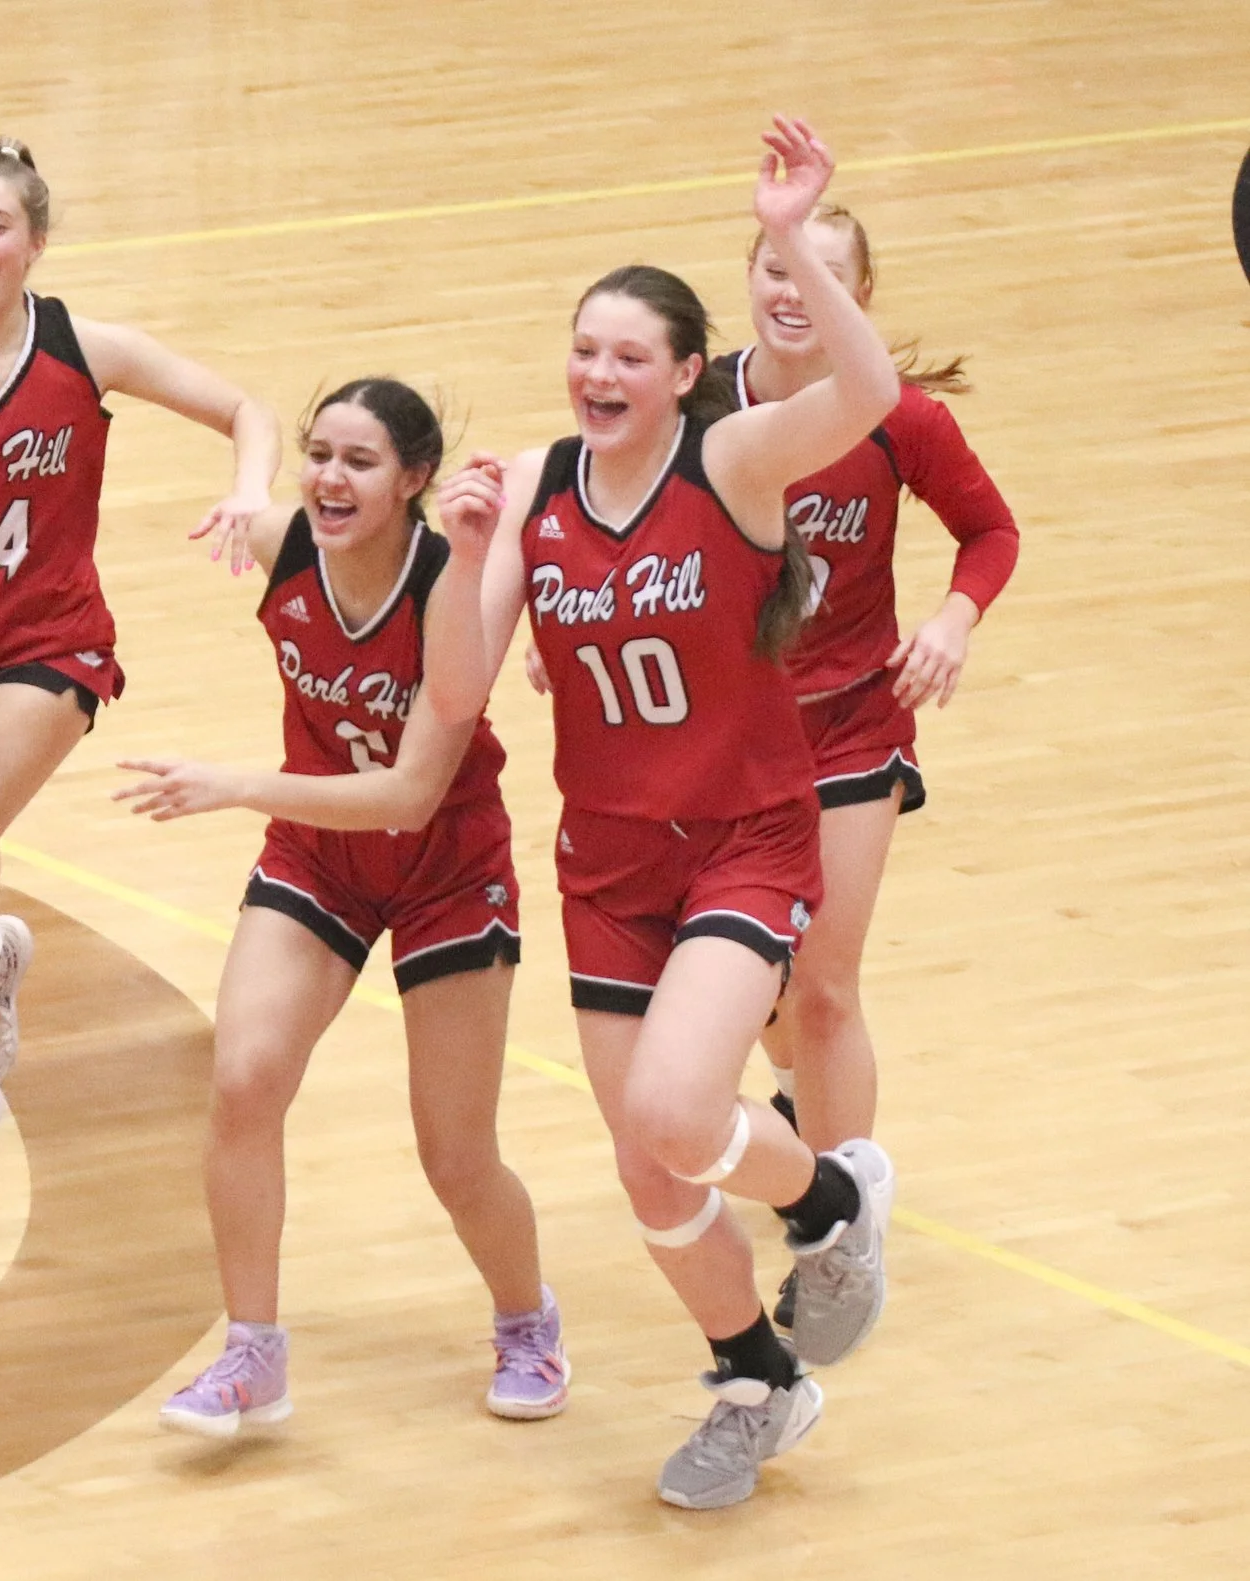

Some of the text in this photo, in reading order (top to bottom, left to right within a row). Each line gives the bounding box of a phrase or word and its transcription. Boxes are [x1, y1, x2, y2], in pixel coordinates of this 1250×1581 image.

[1, 424, 74, 482] Hill
[787, 493, 869, 545] Hill
[532, 549, 706, 628] Park Hill
[280, 638, 355, 707] Park
[575, 636, 690, 725] 10
